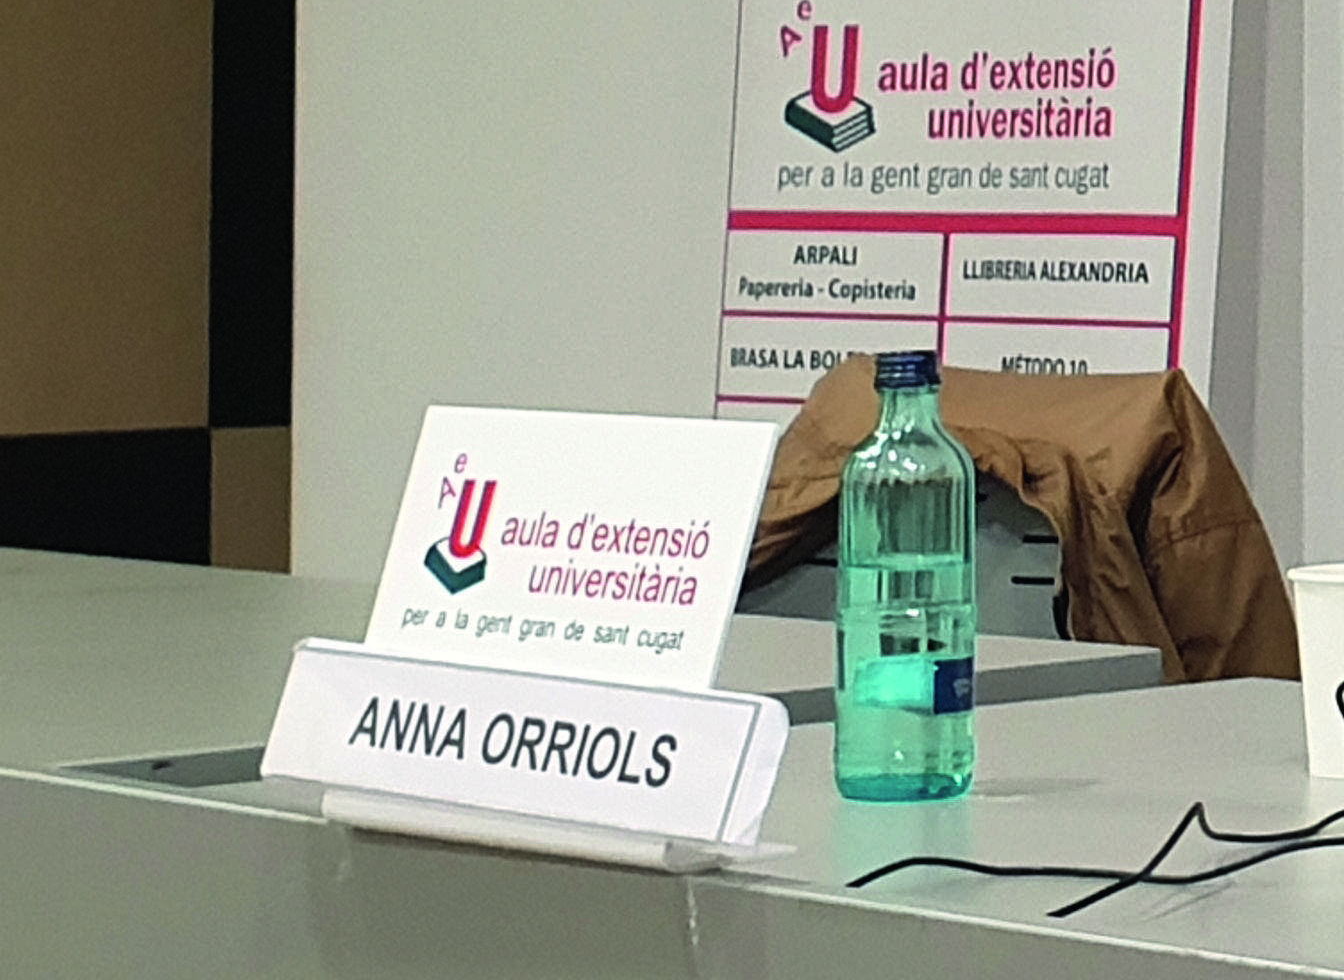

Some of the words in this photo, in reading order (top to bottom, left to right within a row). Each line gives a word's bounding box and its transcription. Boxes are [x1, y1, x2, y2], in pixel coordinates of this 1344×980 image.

[878, 52, 948, 91] aula
[961, 47, 1116, 90] d'extensió
[928, 97, 1112, 138] universitària
[777, 165, 814, 191] per
[820, 167, 835, 188] a
[844, 161, 863, 188] la
[870, 163, 919, 195] gent
[926, 166, 972, 195] gran
[979, 162, 1002, 188] de
[1008, 164, 1049, 188] sant
[1054, 163, 1110, 195] cugat
[793, 245, 858, 266] ARPALI
[963, 260, 1036, 280] LLIBRERIA
[1040, 260, 1149, 284] ALEXANDRIA
[739, 275, 814, 301] Papereria
[828, 277, 917, 303] Copisteria
[730, 347, 779, 368] BRASA
[783, 349, 805, 370] LA
[500, 511, 559, 548] aula
[567, 513, 711, 559] d'extensió
[528, 558, 698, 606] universitària
[401, 607, 429, 629] per
[435, 610, 447, 628] a
[455, 608, 469, 630] la
[476, 615, 513, 638] gent
[518, 619, 556, 642] gran
[564, 619, 585, 641] de
[593, 625, 629, 646] sant
[637, 629, 685, 654] cugat
[348, 696, 467, 760] ANNA
[481, 713, 678, 788] ORRIOLS
